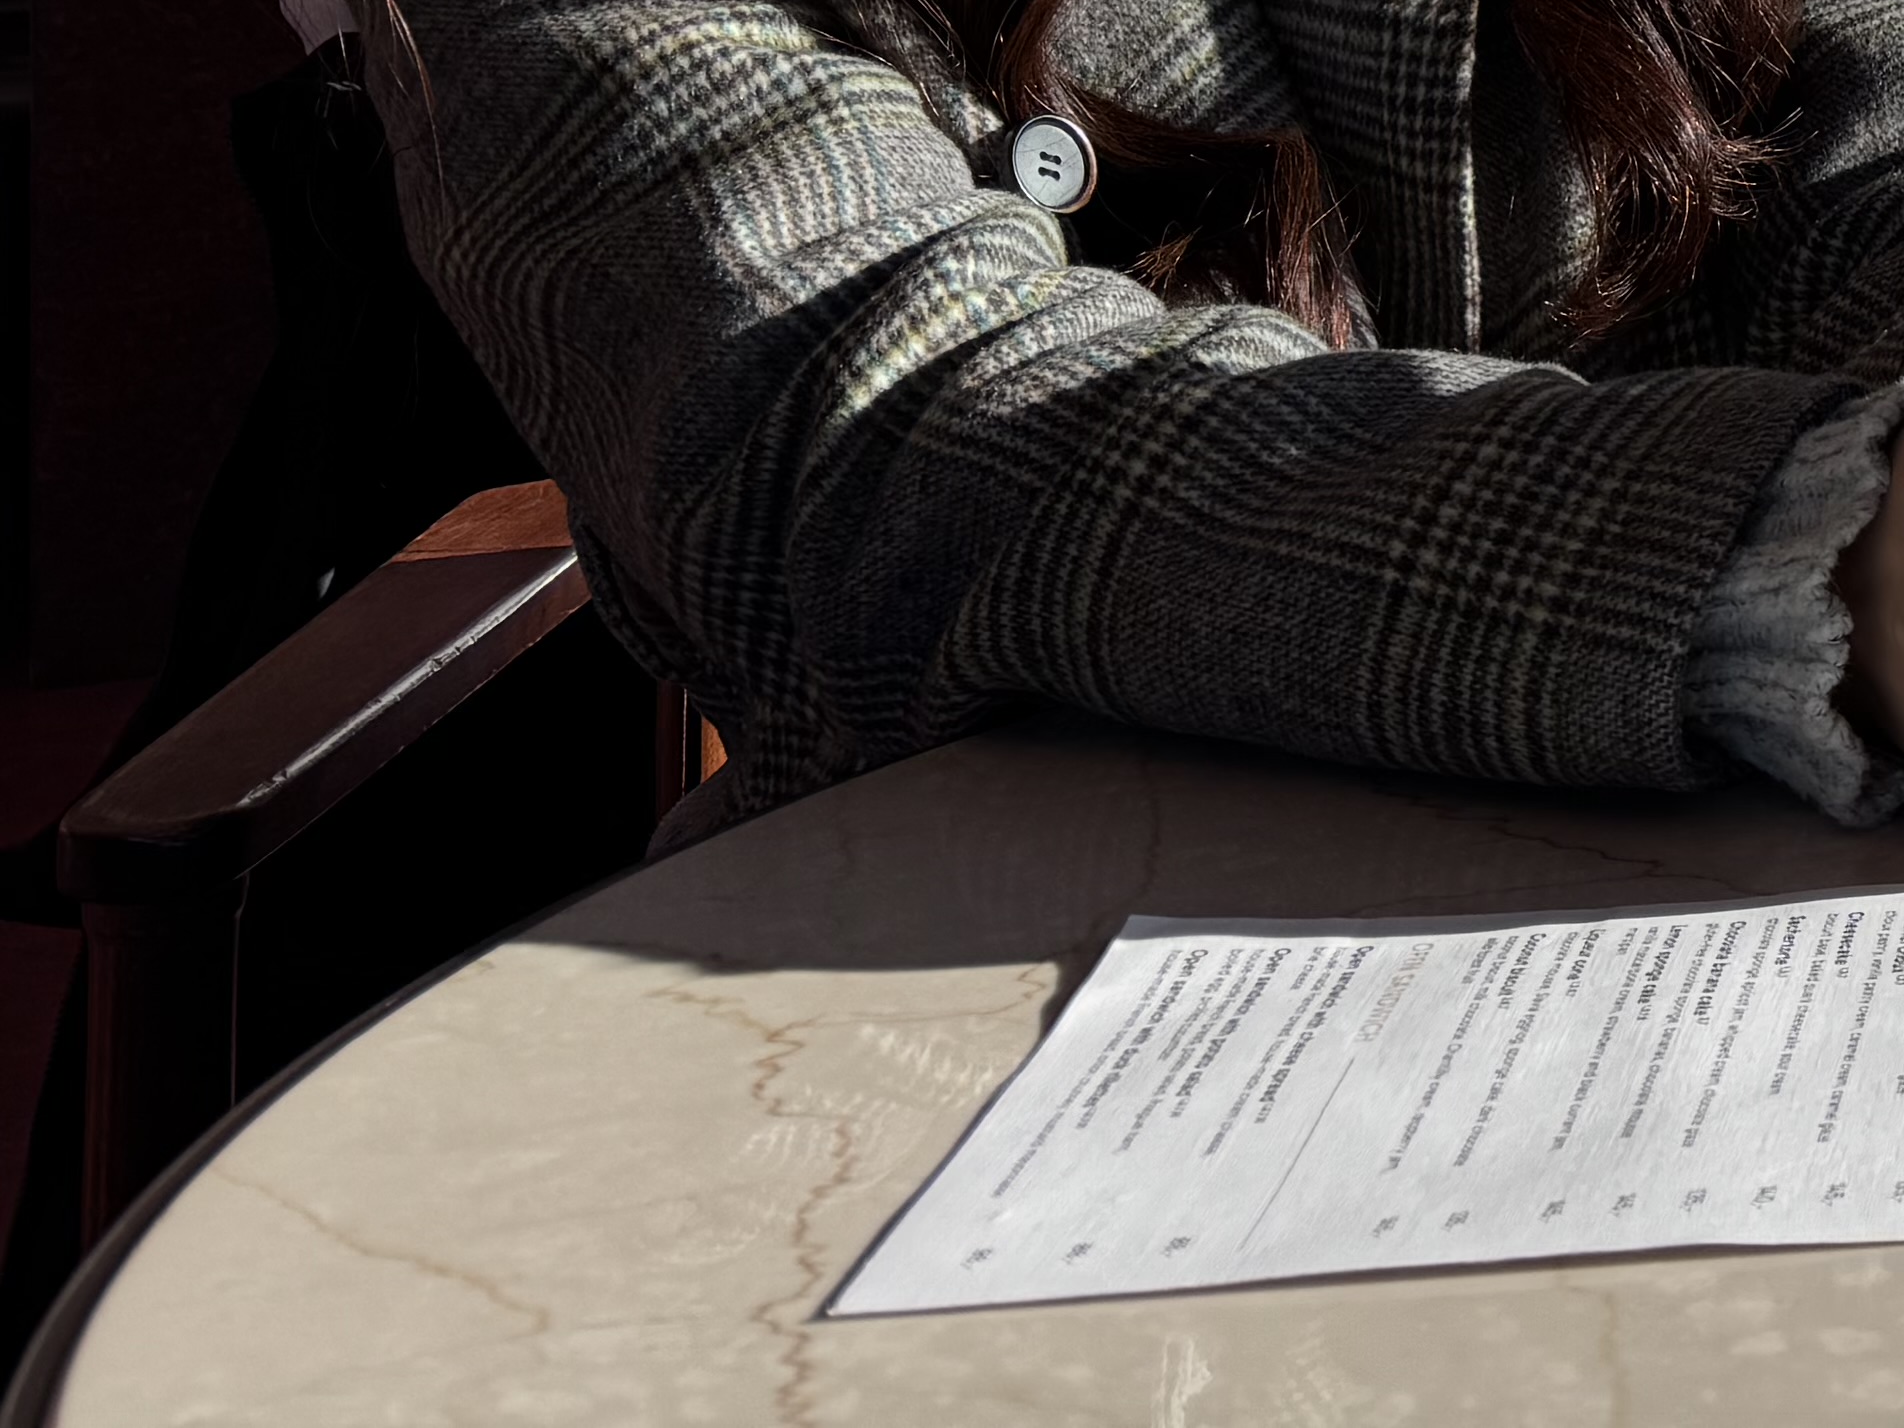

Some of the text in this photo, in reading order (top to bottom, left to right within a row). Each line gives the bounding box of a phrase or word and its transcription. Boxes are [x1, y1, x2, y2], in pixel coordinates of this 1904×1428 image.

[1662, 924, 1687, 949] Lemon
[1178, 949, 1209, 977] Open
[1262, 948, 1292, 974] Open
[1346, 945, 1375, 969] Open
[1354, 942, 1434, 1042] OPEN SANDWICH
[1637, 984, 1656, 1003] cake
[1693, 995, 1713, 1015] cake
